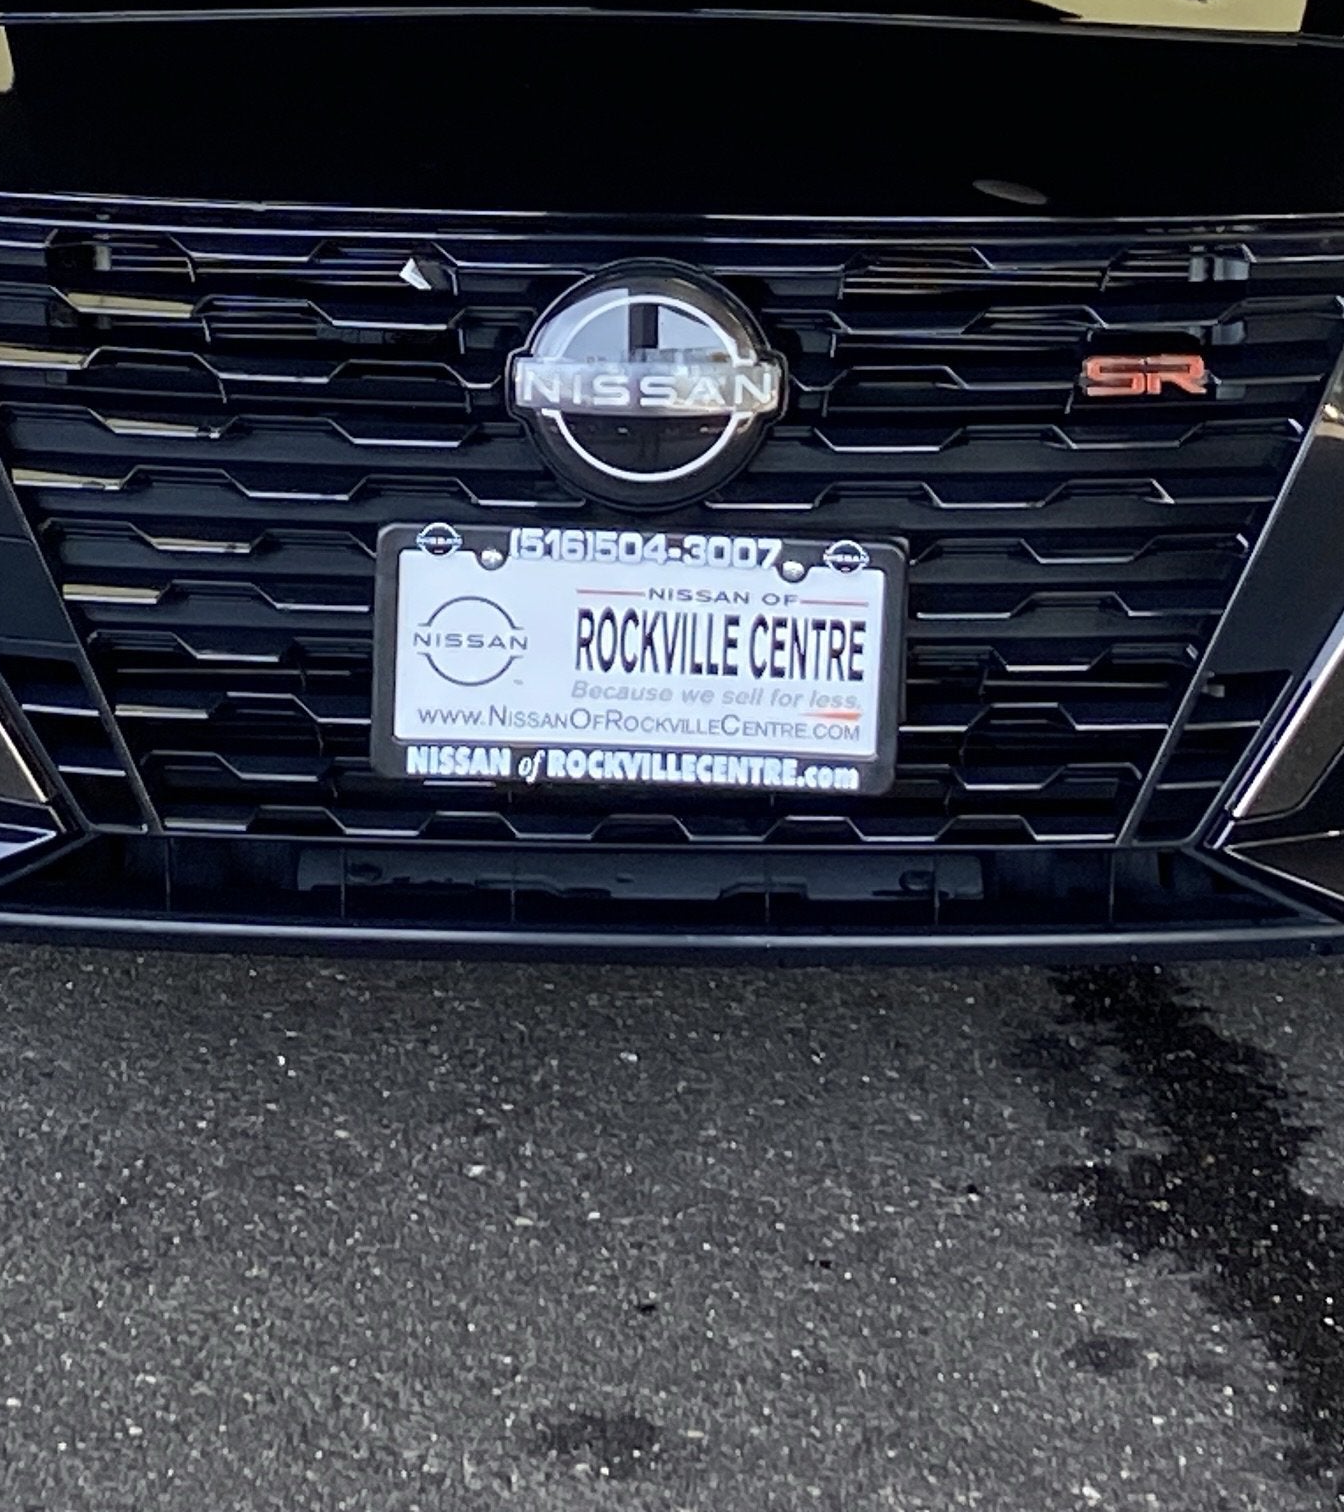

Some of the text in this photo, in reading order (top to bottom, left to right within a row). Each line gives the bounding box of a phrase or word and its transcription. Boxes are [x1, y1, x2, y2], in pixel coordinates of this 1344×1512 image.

[522, 368, 771, 406] NISSAN
[1083, 354, 1207, 397] SR
[509, 527, 782, 570] (516)504-3007
[648, 588, 800, 606] NISSAN OF
[413, 630, 529, 651] NISSAN
[575, 607, 867, 682] ROCKVILLE CENTRE
[571, 679, 674, 702] Because
[680, 688, 716, 704] we
[721, 687, 764, 706] sell
[770, 688, 804, 708] for
[406, 745, 860, 790] NISSAN of ROCKVILLECENTRE.com
